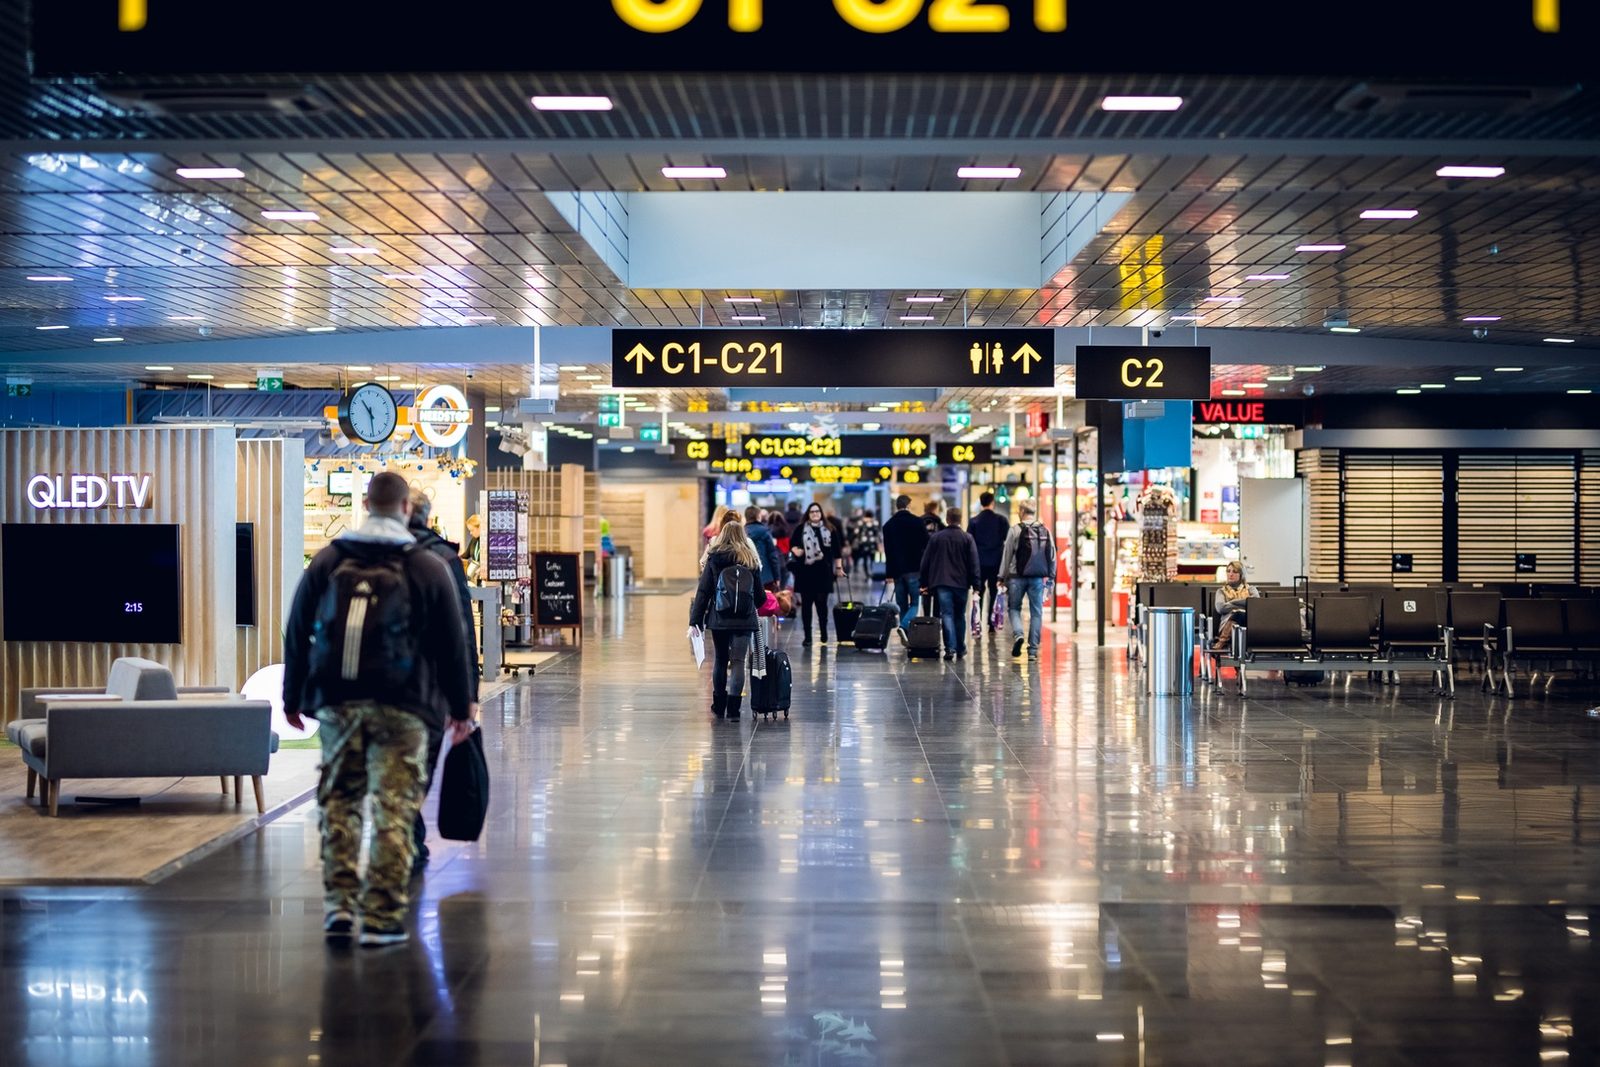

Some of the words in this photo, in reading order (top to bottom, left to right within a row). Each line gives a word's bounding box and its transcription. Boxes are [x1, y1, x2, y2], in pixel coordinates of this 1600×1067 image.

[661, 342, 783, 374] C1-C21
[1121, 358, 1164, 388] C2
[1200, 402, 1265, 421] VALUE
[686, 441, 709, 458] C3
[760, 437, 841, 457] C1,C3-C21
[952, 445, 975, 462] C4
[27, 475, 108, 508] QLED
[111, 475, 150, 508] TV
[124, 602, 143, 613] 2:15
